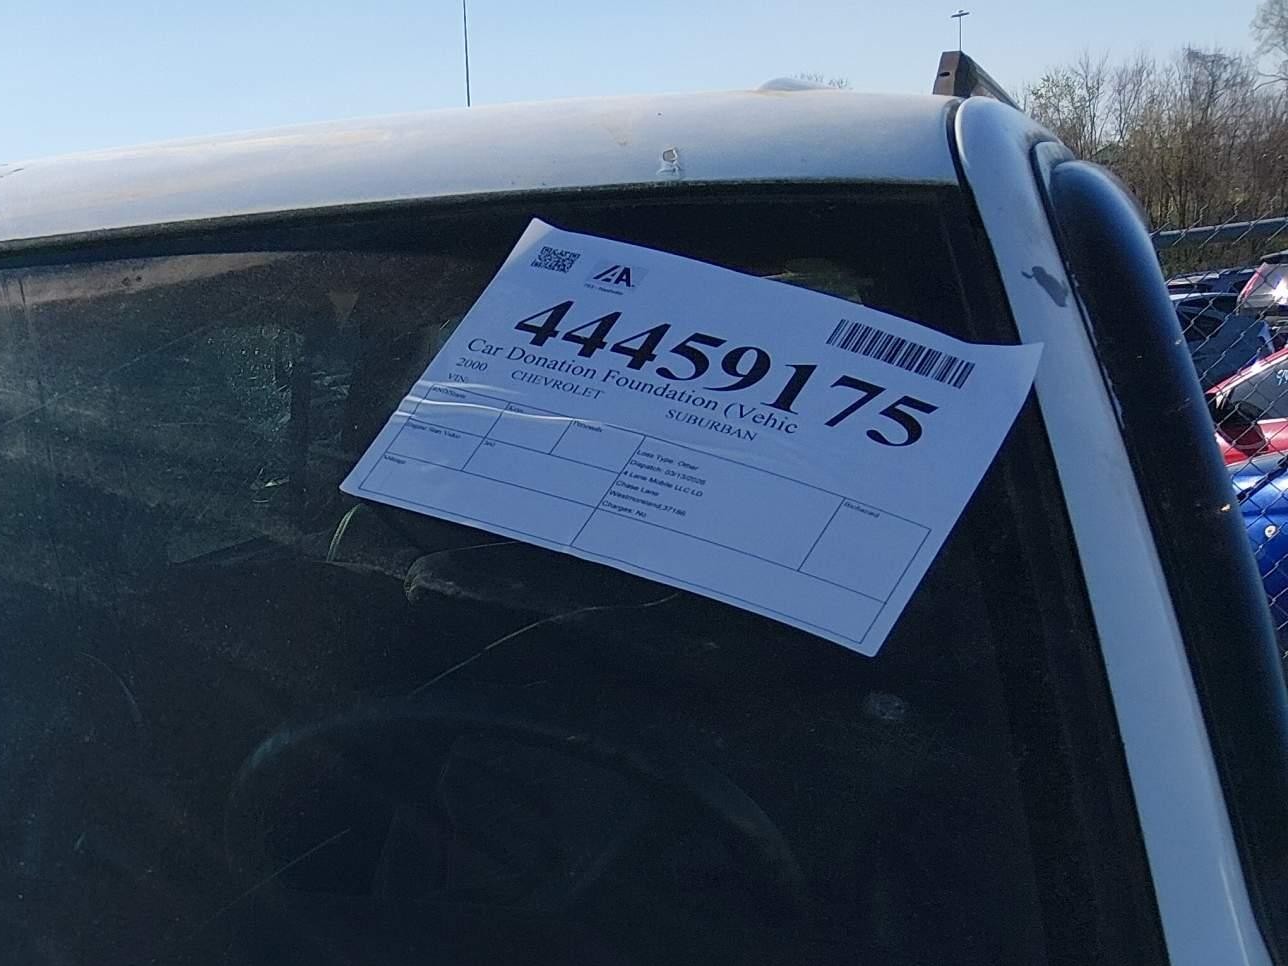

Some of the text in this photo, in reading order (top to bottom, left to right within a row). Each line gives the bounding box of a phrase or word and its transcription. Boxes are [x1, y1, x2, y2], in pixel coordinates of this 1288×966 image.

[456, 357, 758, 441] 2000 CHEVROLET SUBURBAN
[468, 338, 798, 434] Car Donation Foundation (Vehic
[514, 300, 938, 447] 44459175
